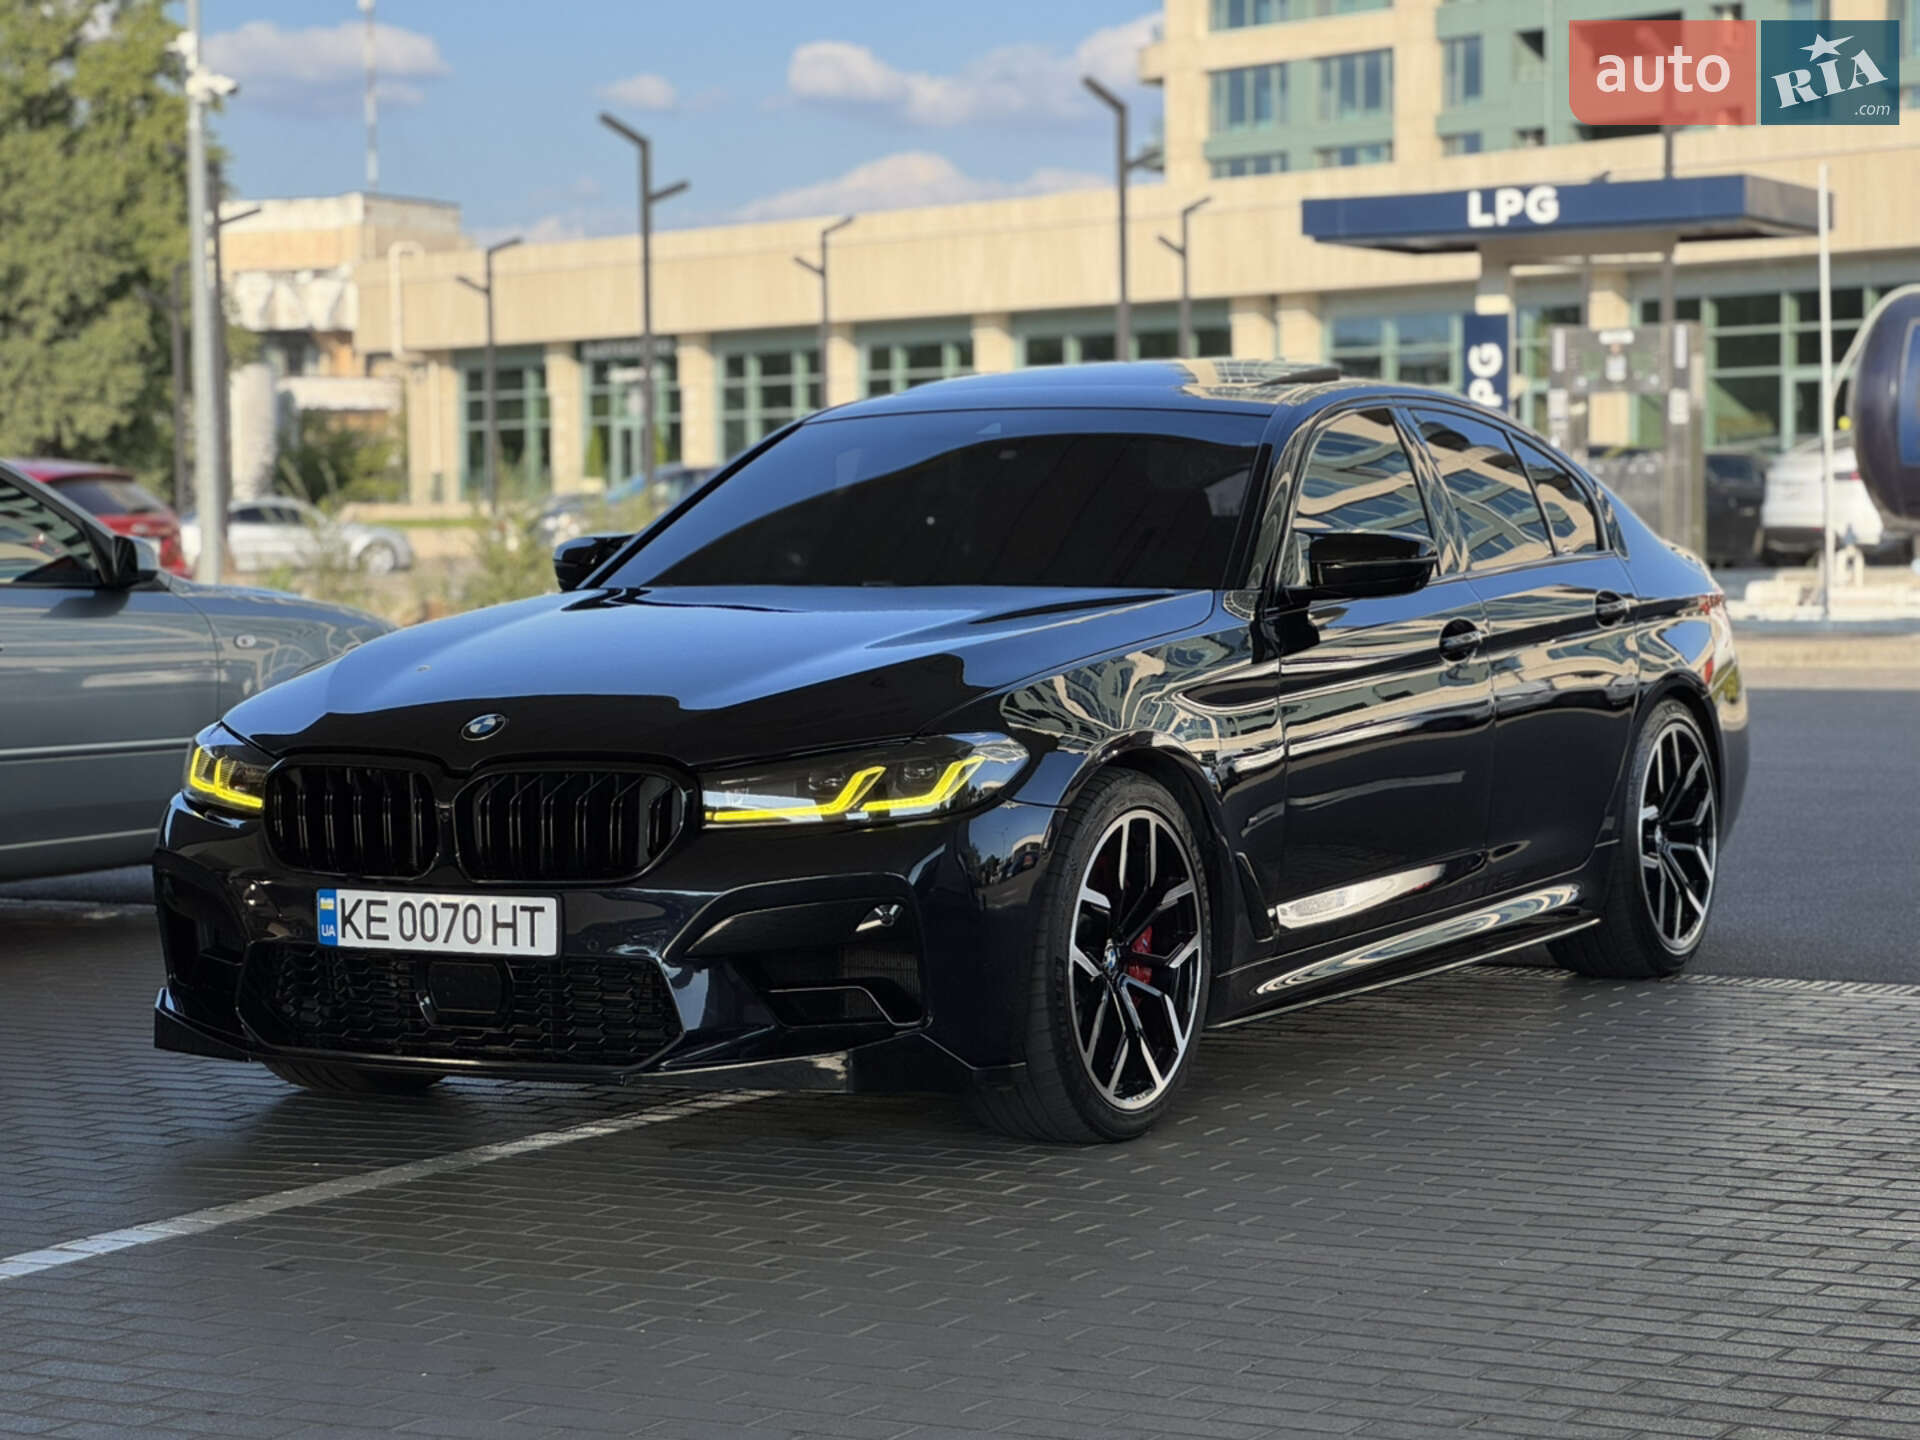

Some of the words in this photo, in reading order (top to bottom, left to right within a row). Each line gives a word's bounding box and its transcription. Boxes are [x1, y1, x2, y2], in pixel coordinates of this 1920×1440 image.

[1467, 185, 1560, 228] LPG
[1467, 342, 1503, 408] PG
[321, 924, 337, 937] UA
[340, 898, 390, 941] KE
[398, 901, 482, 945] 0070
[492, 904, 545, 948] HT
